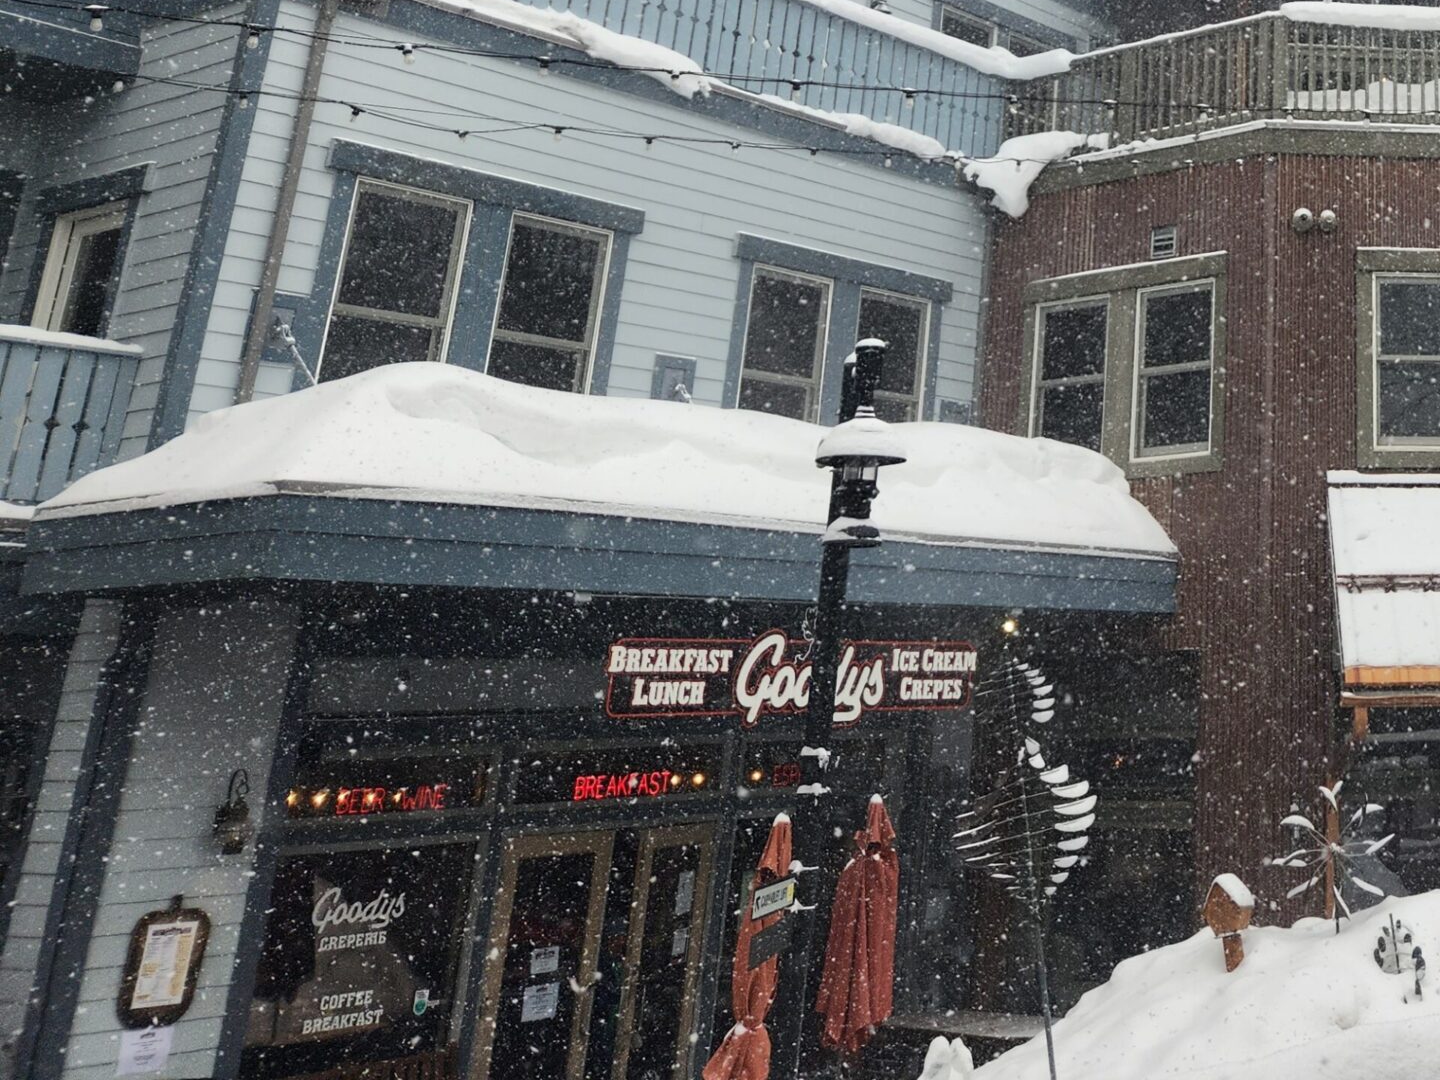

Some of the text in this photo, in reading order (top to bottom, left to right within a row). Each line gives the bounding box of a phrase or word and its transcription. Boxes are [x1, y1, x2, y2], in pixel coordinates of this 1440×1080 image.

[608, 644, 734, 674] BREAKFAST
[892, 648, 978, 673] ICE CREAM
[631, 677, 707, 707] LUNCH
[899, 676, 963, 700] CREPES
[335, 782, 449, 815] BEER WINE
[573, 770, 671, 802] BREAKFAST
[311, 887, 406, 934] Goodys
[317, 931, 388, 952] CREPERIE
[320, 990, 374, 1011] COFFEE
[302, 1009, 385, 1035] BREAKFAST
